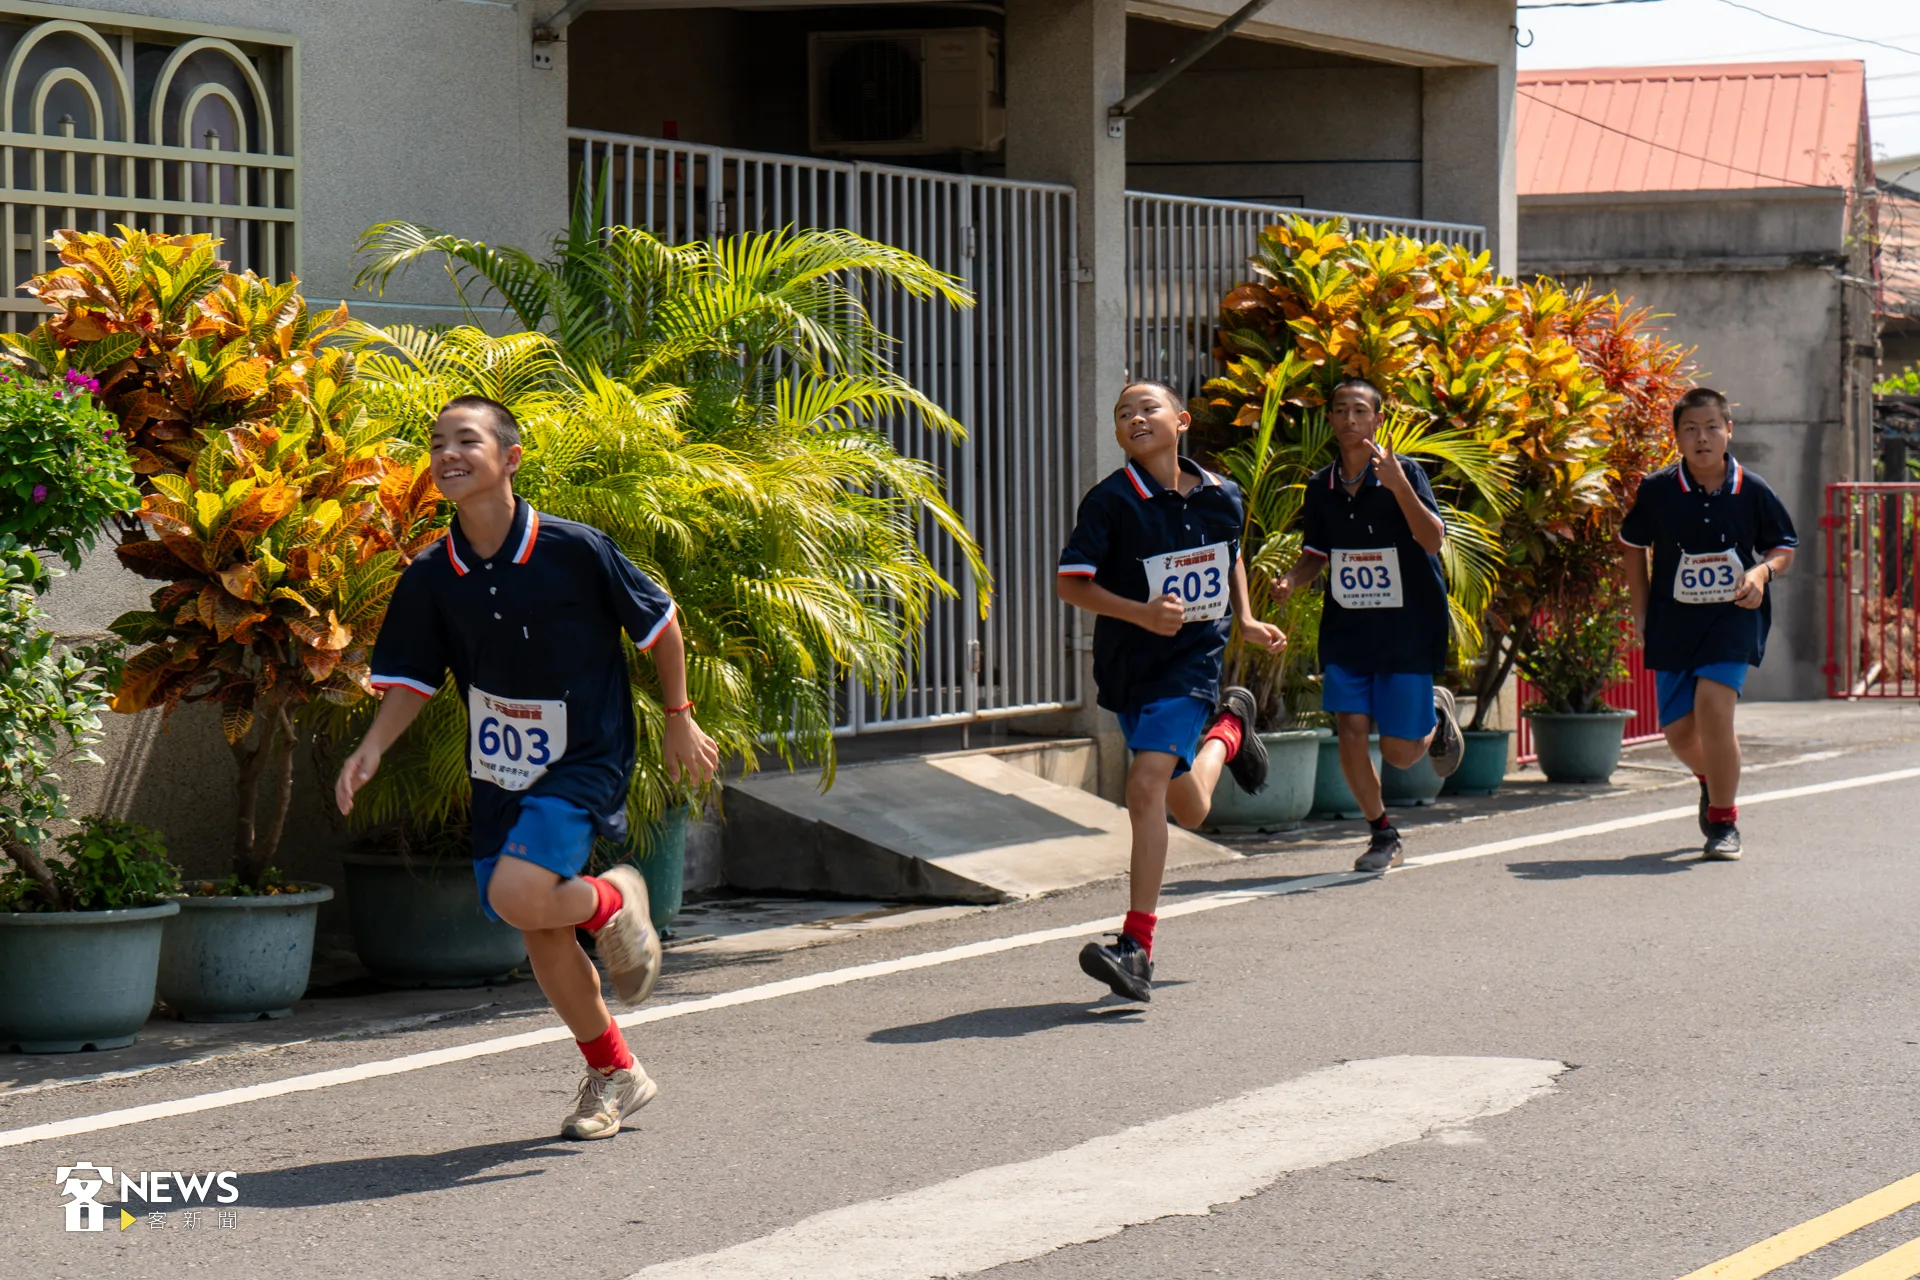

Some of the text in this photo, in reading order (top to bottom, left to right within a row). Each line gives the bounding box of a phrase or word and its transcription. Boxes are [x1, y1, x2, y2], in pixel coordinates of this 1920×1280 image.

[1340, 566, 1391, 590] 603
[1681, 565, 1734, 588] 603
[479, 717, 551, 766] 603
